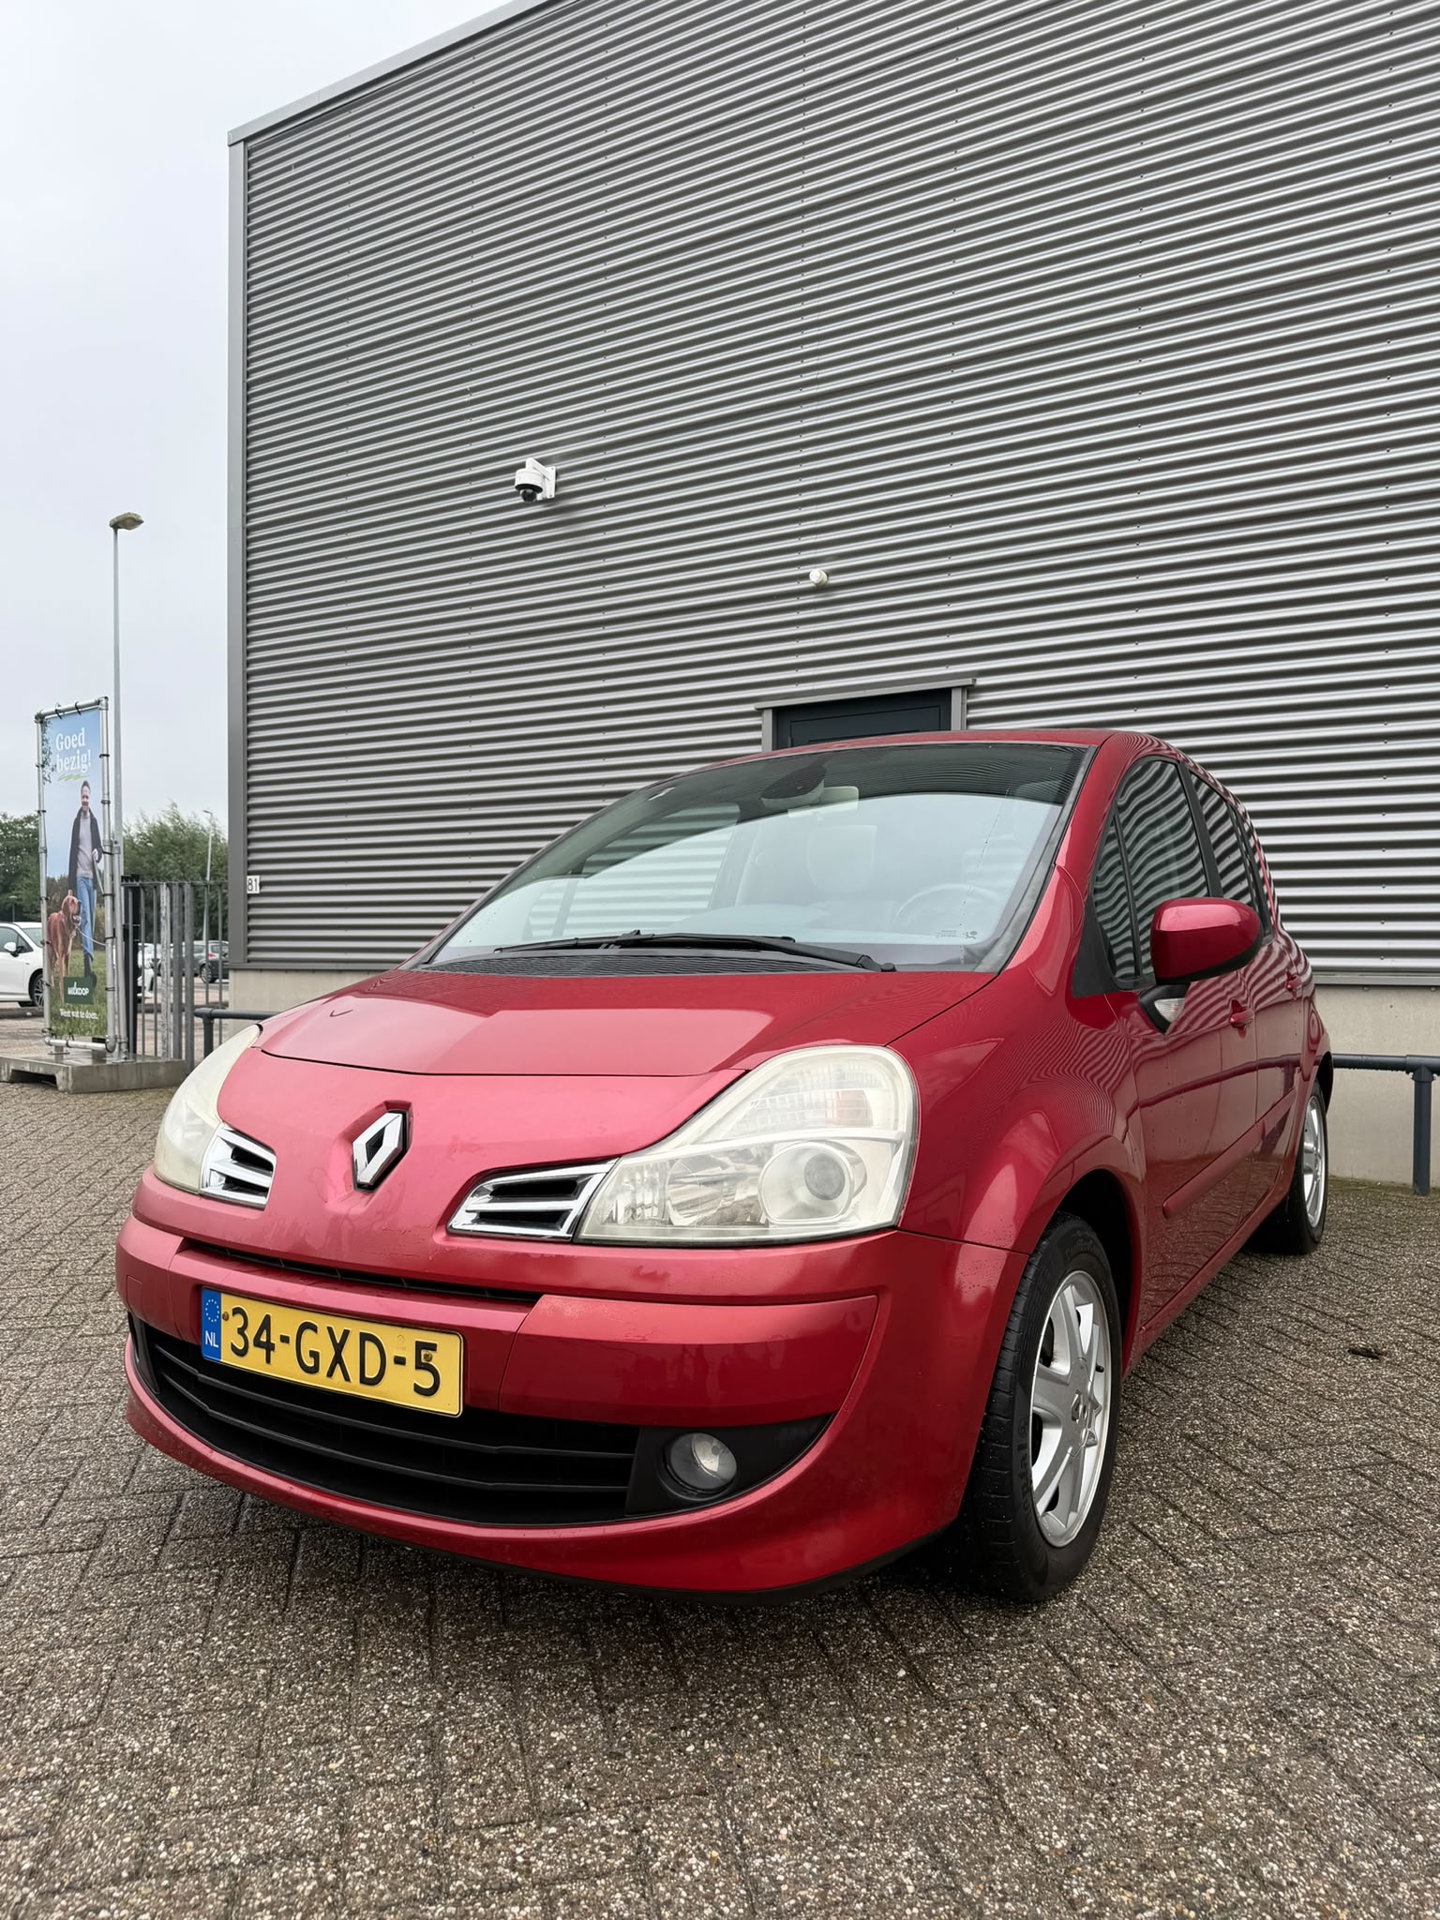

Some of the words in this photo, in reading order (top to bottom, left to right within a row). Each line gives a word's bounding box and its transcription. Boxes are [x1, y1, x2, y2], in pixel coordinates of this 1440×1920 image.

[56, 727, 86, 751] Goed
[56, 749, 91, 773] bezig!
[247, 878, 258, 892] 81
[67, 981, 90, 996] LKOOP
[204, 1329, 219, 1349] NL
[230, 1306, 441, 1397] 34-GXD-5
